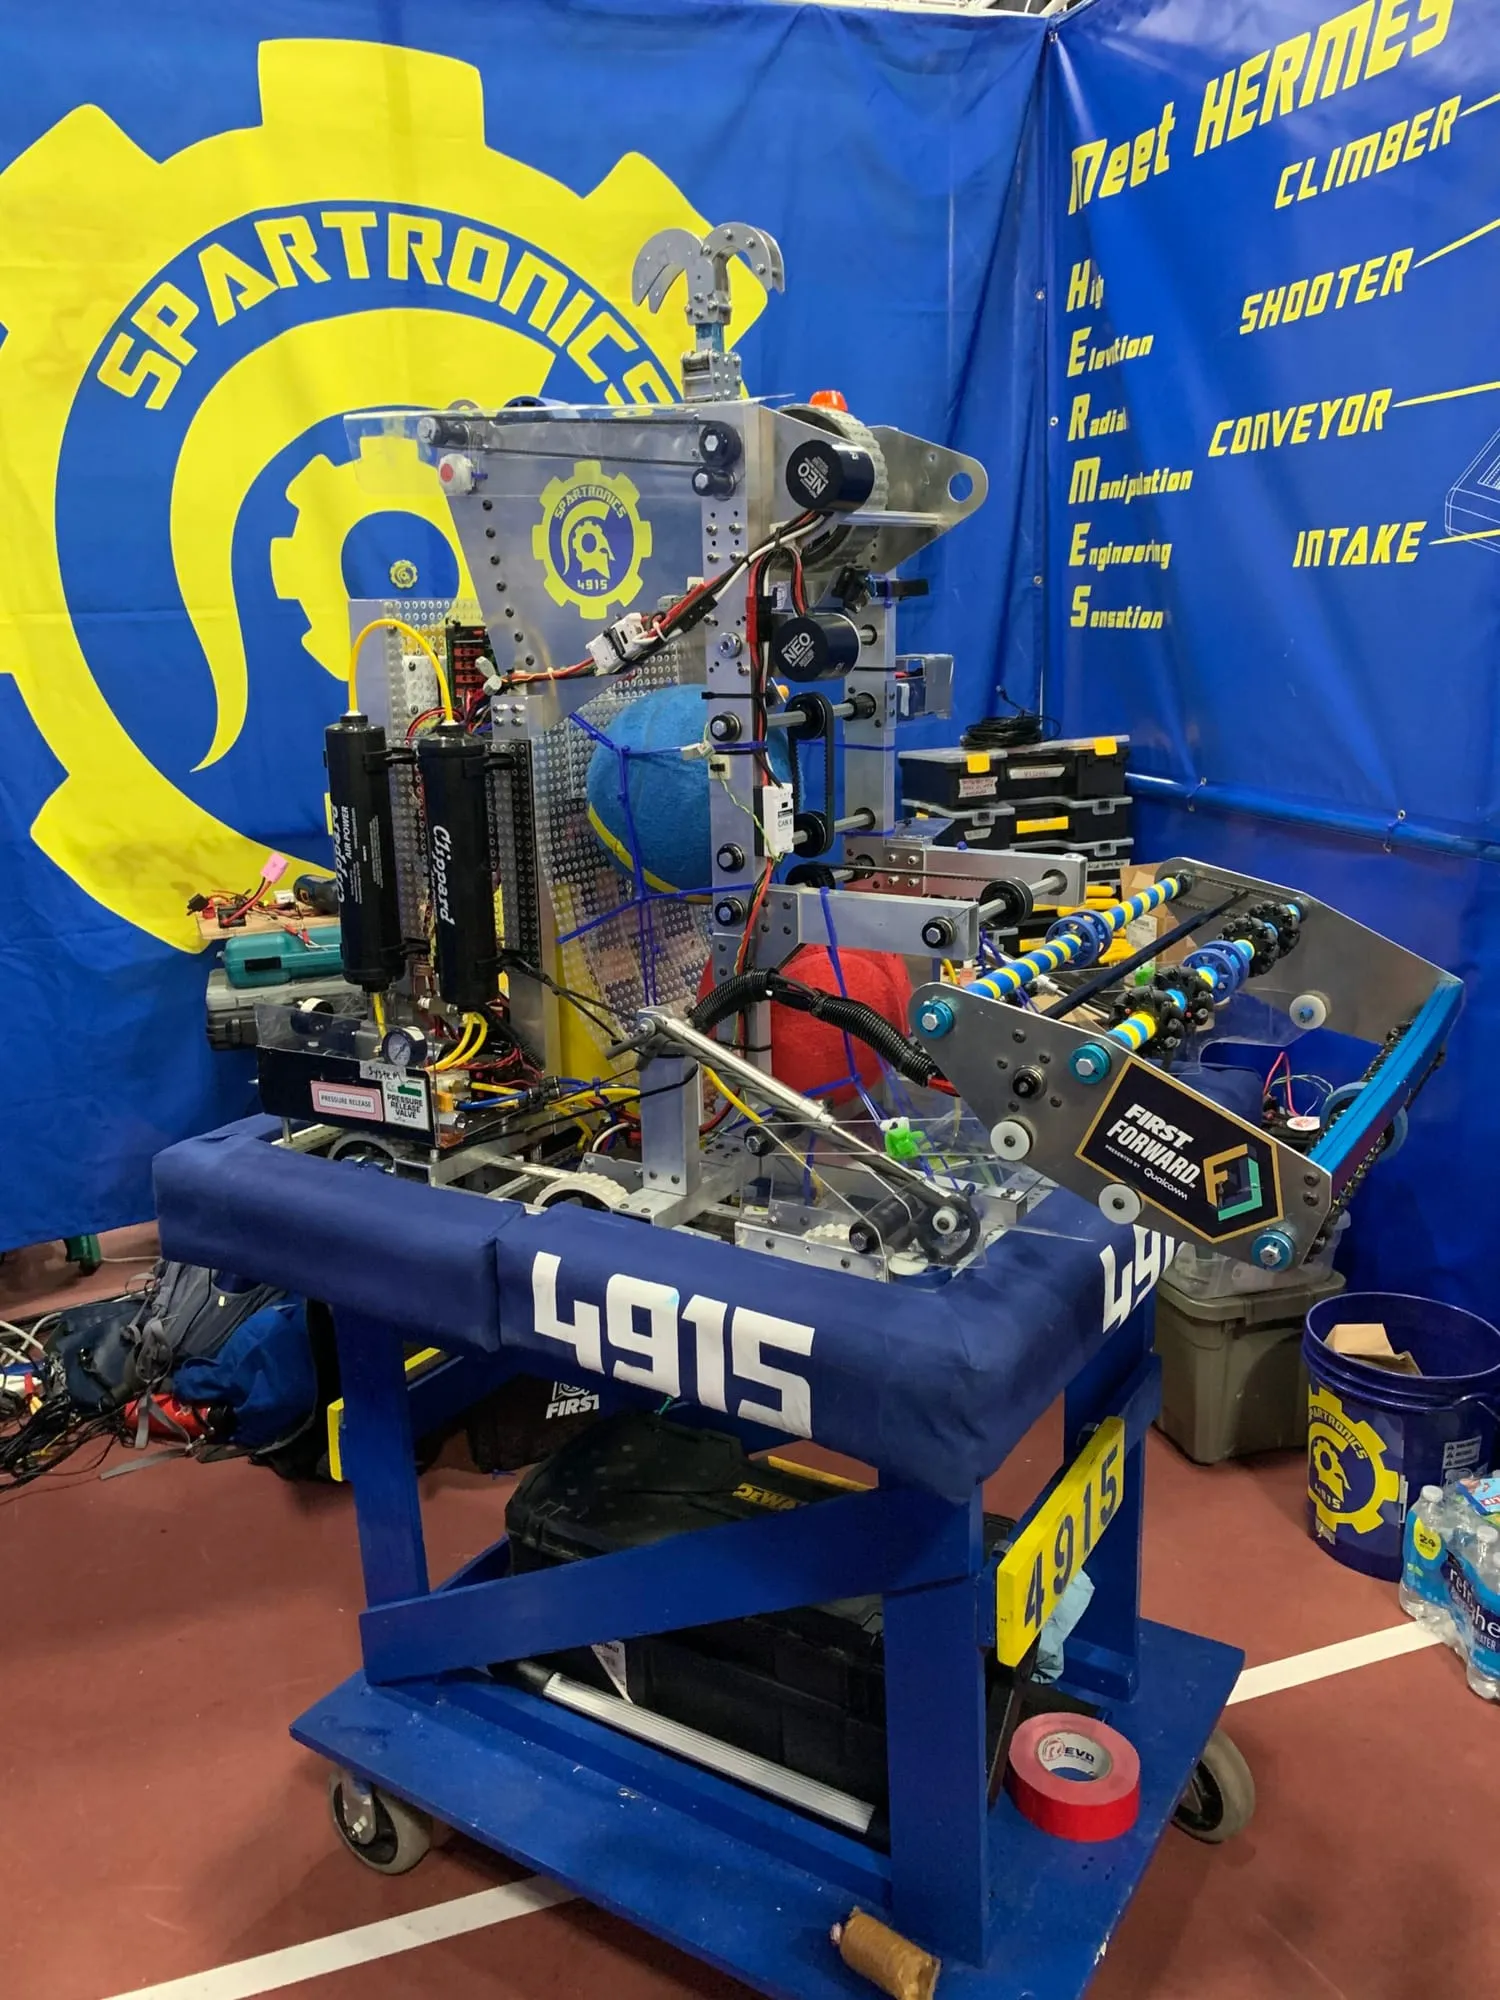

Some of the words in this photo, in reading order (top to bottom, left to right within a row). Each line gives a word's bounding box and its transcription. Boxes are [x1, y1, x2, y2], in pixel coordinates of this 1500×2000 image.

[1068, 101, 1176, 215] Meet
[1194, 0, 1454, 157] HERMES
[1275, 95, 1461, 209] CLIMBER
[97, 210, 674, 417] SPARTRONICS
[1240, 248, 1414, 335] SHOOTER
[1208, 389, 1392, 457] CONVEYOR
[798, 462, 827, 495] NEO
[554, 485, 627, 521] SPARTRONICS
[1293, 521, 1427, 567] INTAKE
[577, 579, 608, 590] 4915
[1070, 585, 1164, 629] Sensation
[783, 632, 811, 665] NEO
[321, 1094, 347, 1105] PRESSURE
[349, 1098, 371, 1108] RELEASE
[387, 1093, 423, 1107] PRESSURE
[390, 1101, 421, 1113] RELEASE
[395, 1109, 417, 1119] VALVE
[1124, 1103, 1194, 1149] FIRST
[1104, 1144, 1133, 1165] PRESENTED
[1143, 1167, 1188, 1201] Qualcomm
[532, 1251, 815, 1439] 4915
[1024, 1444, 1118, 1629] 4915
